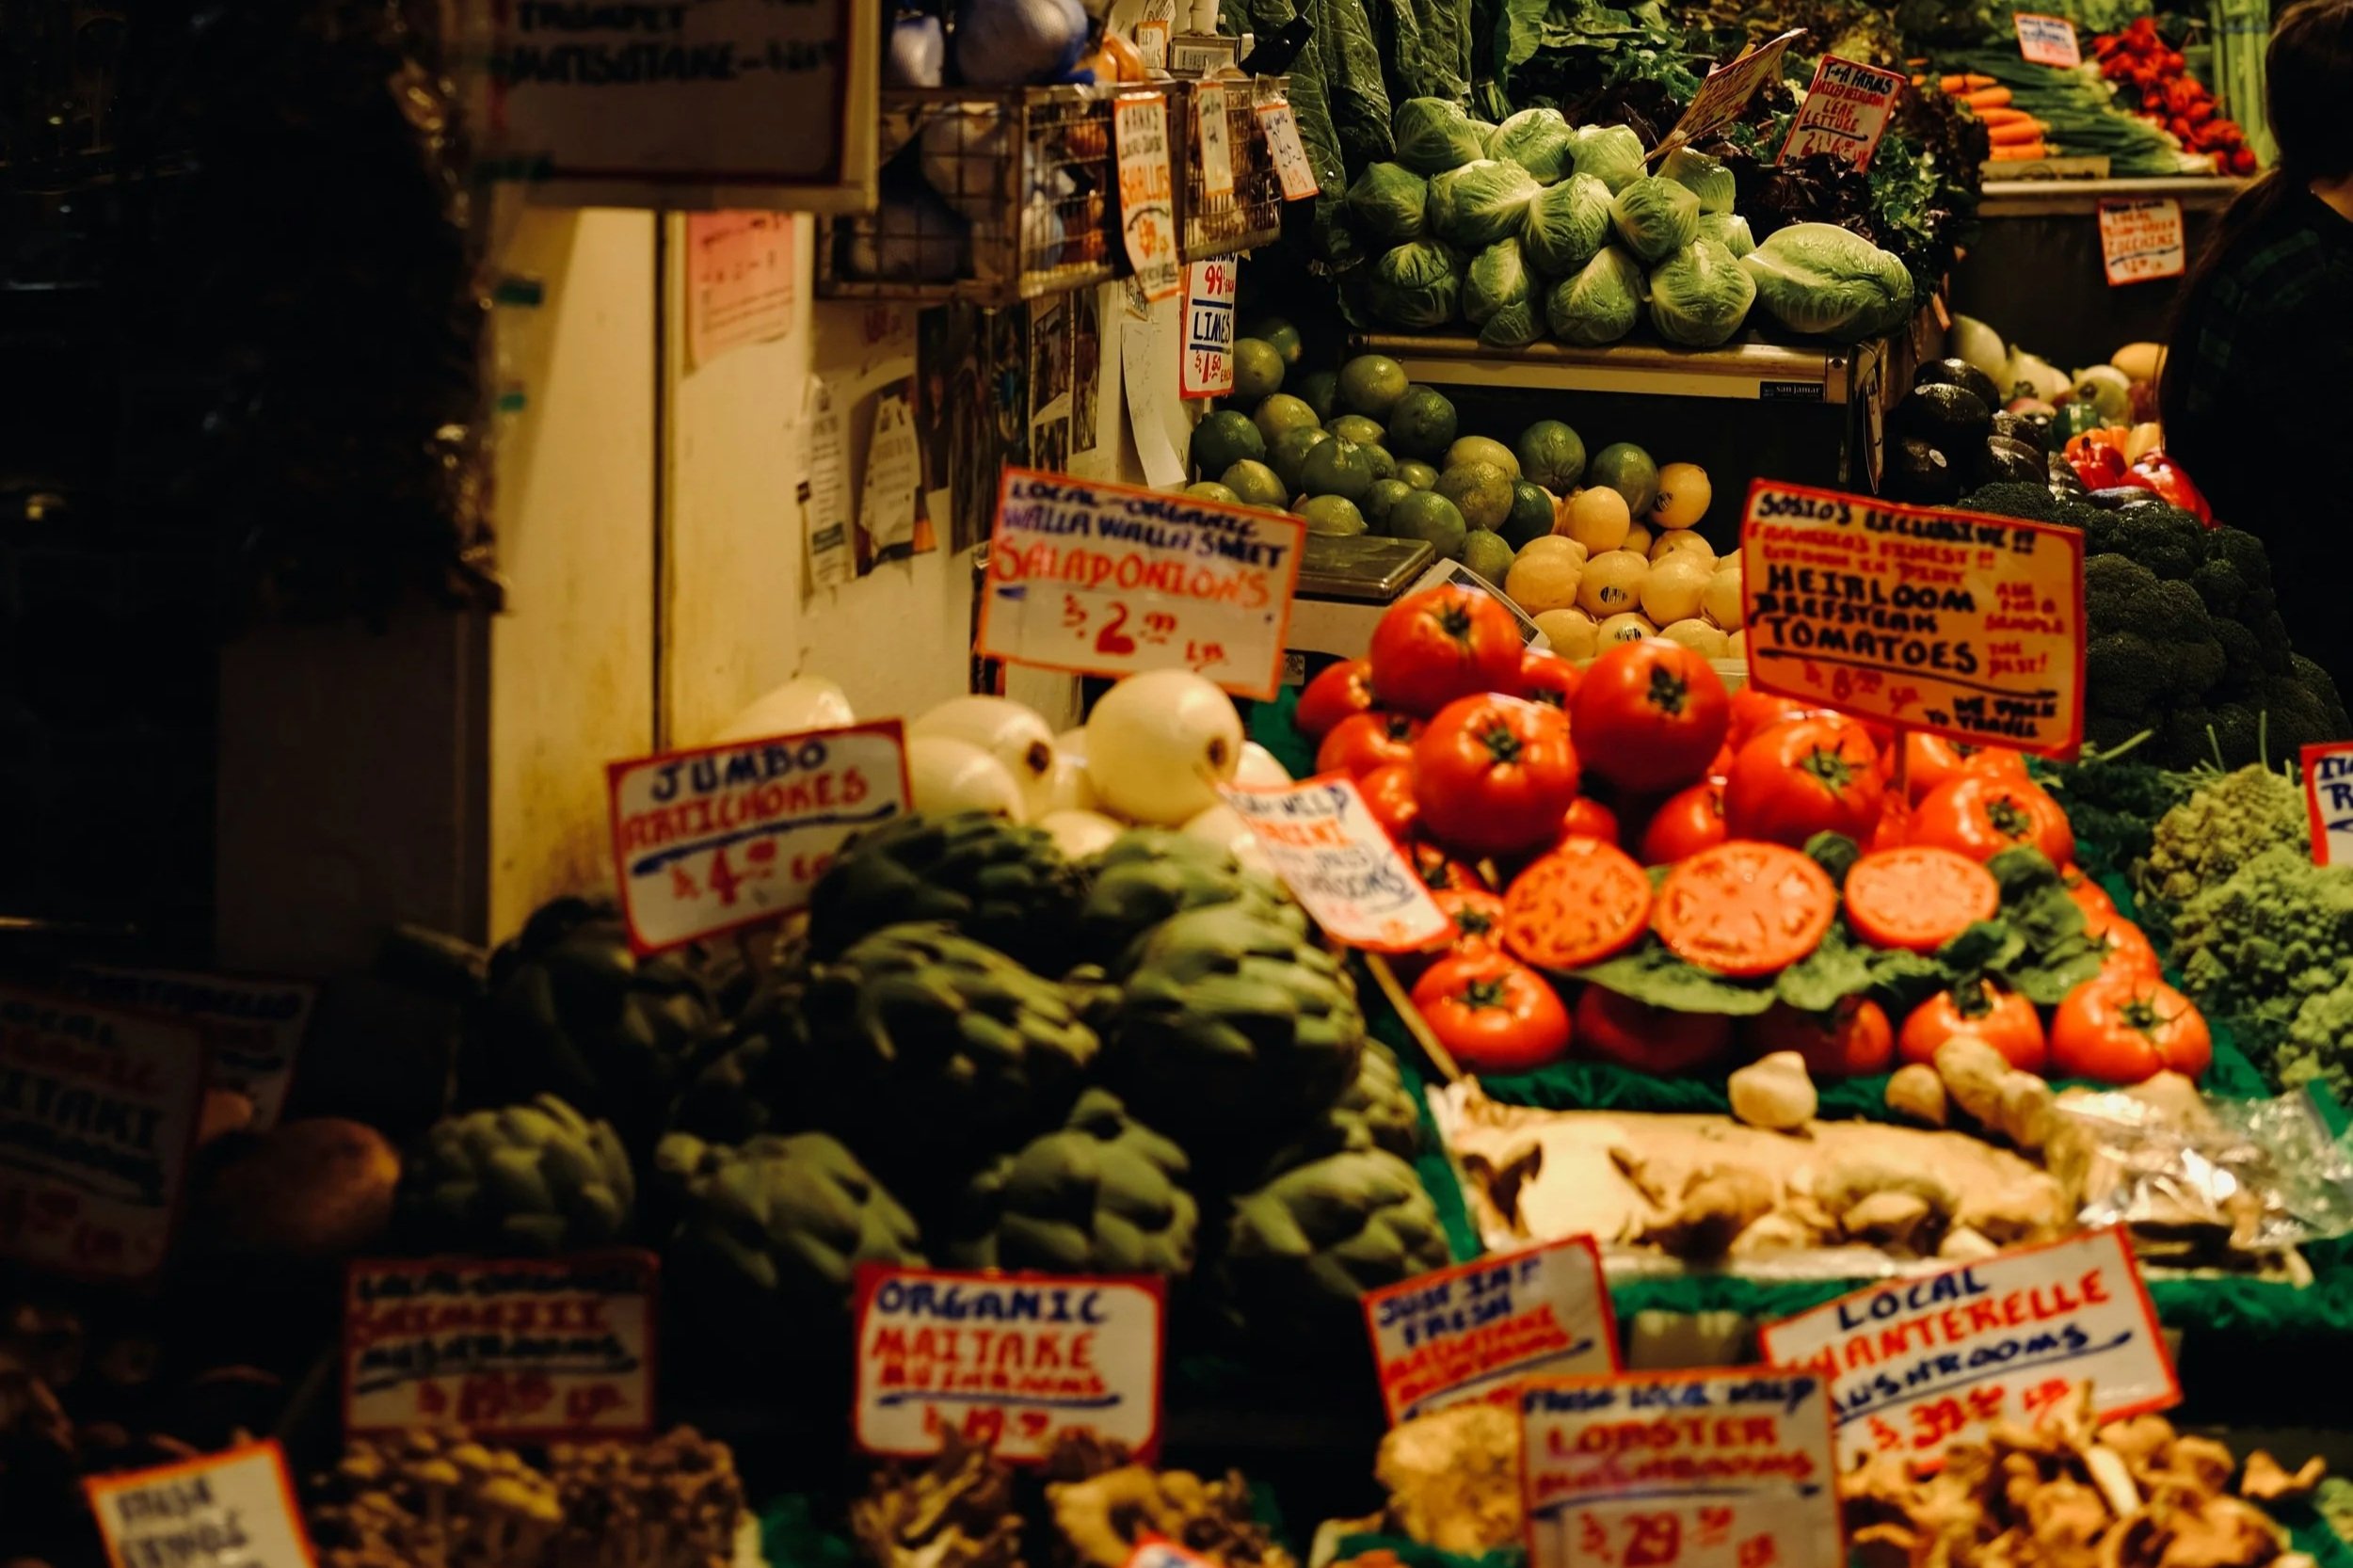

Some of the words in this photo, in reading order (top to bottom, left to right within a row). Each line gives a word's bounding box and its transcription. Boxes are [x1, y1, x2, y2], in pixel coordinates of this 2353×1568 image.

[1802, 110, 1860, 133] LETTUCE
[1193, 312, 1231, 344] LIMES
[1003, 504, 1090, 536] WALLA
[1098, 514, 1192, 550] WALLA
[1758, 492, 1852, 525] SOSIO'S
[1768, 564, 1977, 614] HEIRLOOM
[1766, 616, 1978, 675] TOMATOES
[650, 739, 828, 802] JUMBO
[626, 768, 870, 847] ARTICHOKES
[877, 1279, 1106, 1323] ORGANIC
[1836, 1266, 1989, 1332] LOCAL
[872, 1326, 1096, 1369] MAITAKE
[1546, 1416, 1777, 1457] LOBSTER
